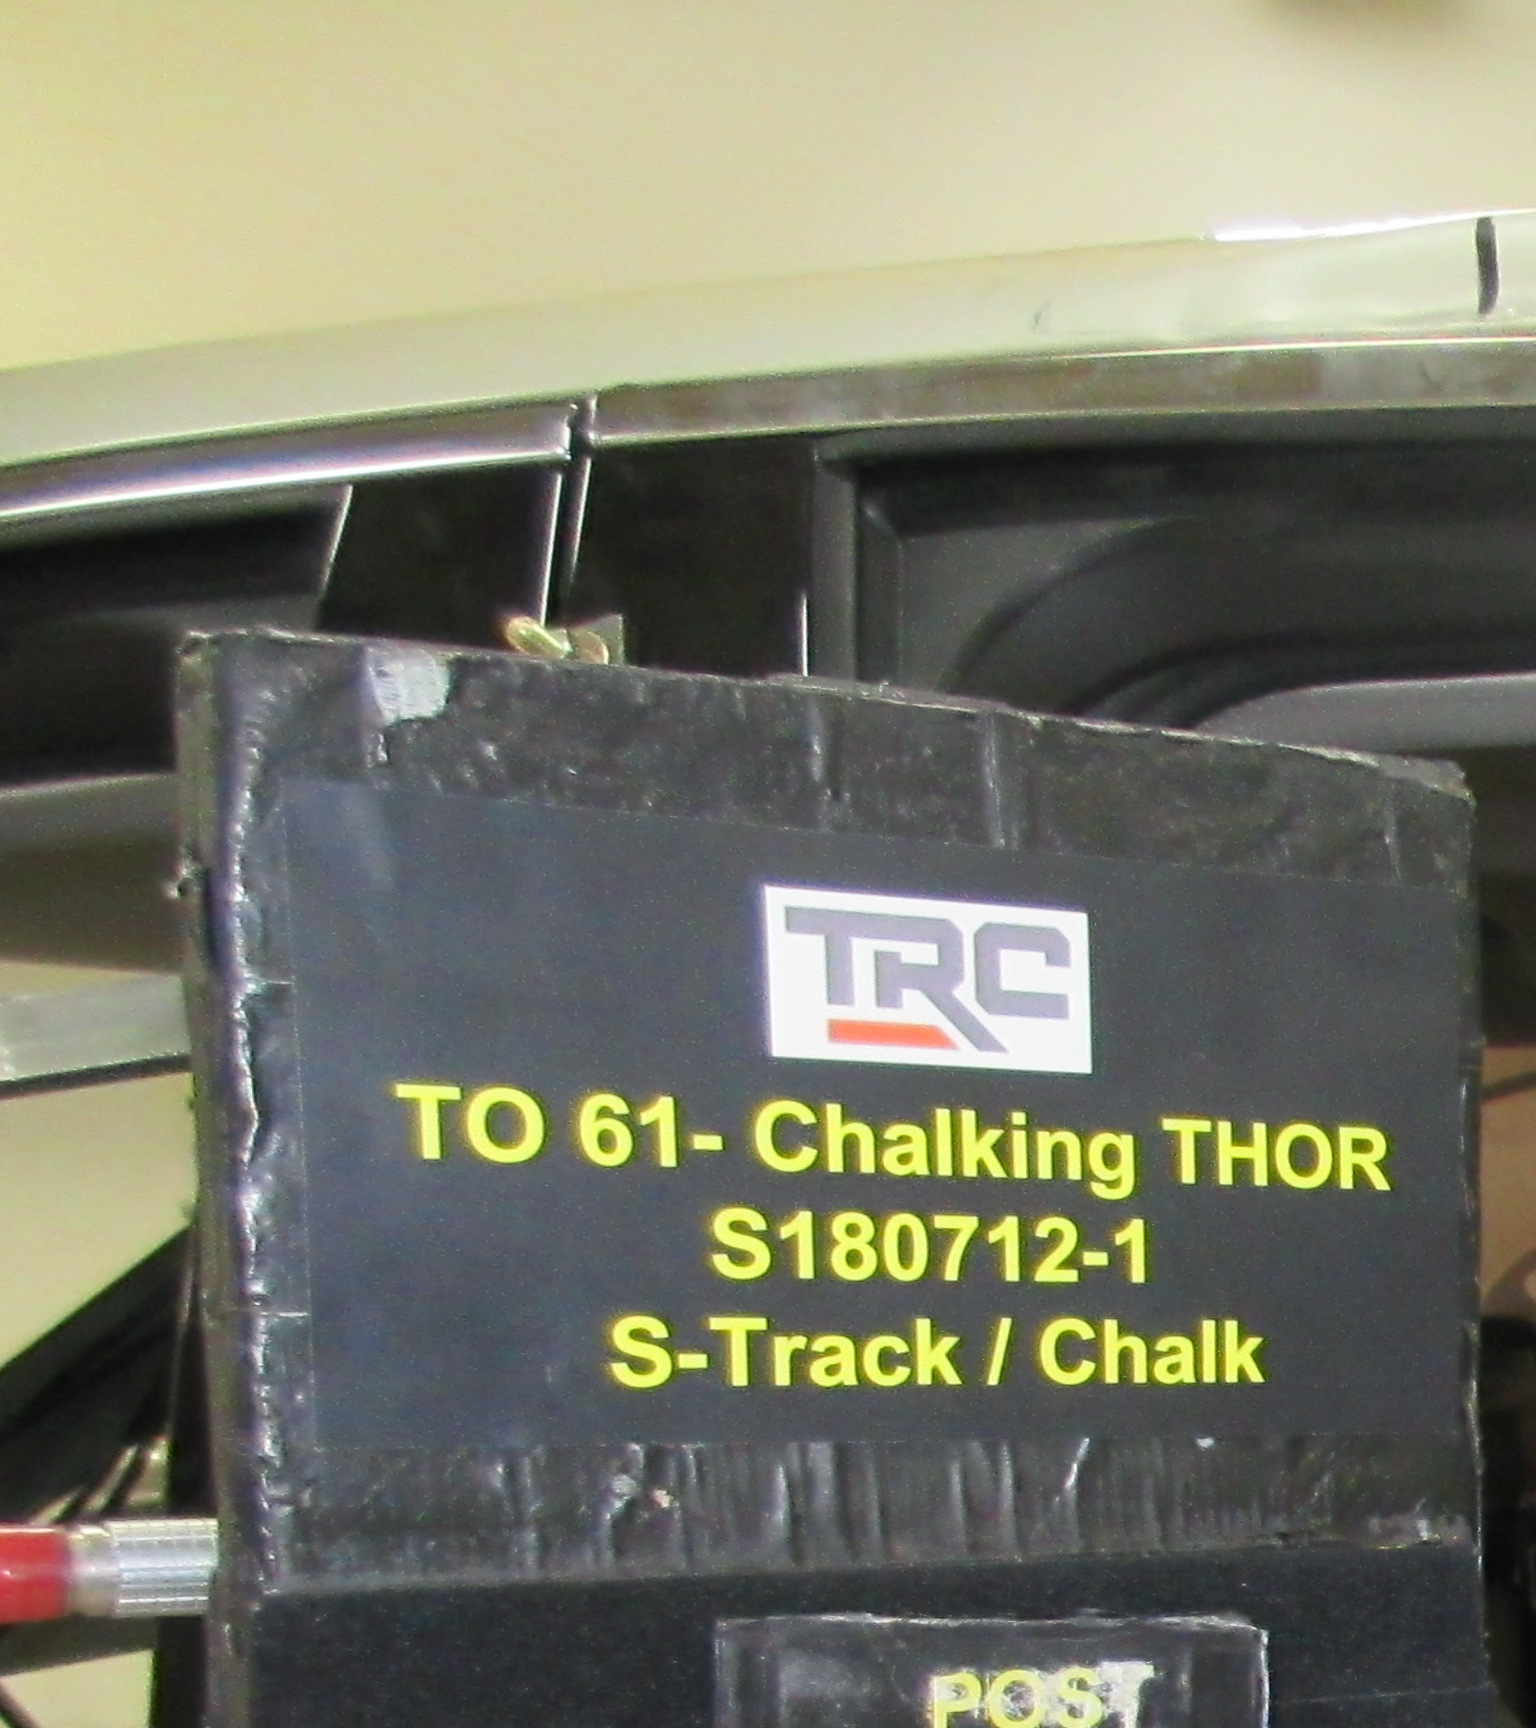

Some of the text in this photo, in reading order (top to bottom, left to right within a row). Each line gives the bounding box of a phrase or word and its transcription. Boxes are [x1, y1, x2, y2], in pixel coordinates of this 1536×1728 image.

[784, 906, 1071, 1053] TRC
[394, 1082, 1392, 1200] TO 61- Chalking THOR
[709, 1207, 1149, 1286] S180712-1
[607, 1314, 1266, 1389] S-Track / Chalk
